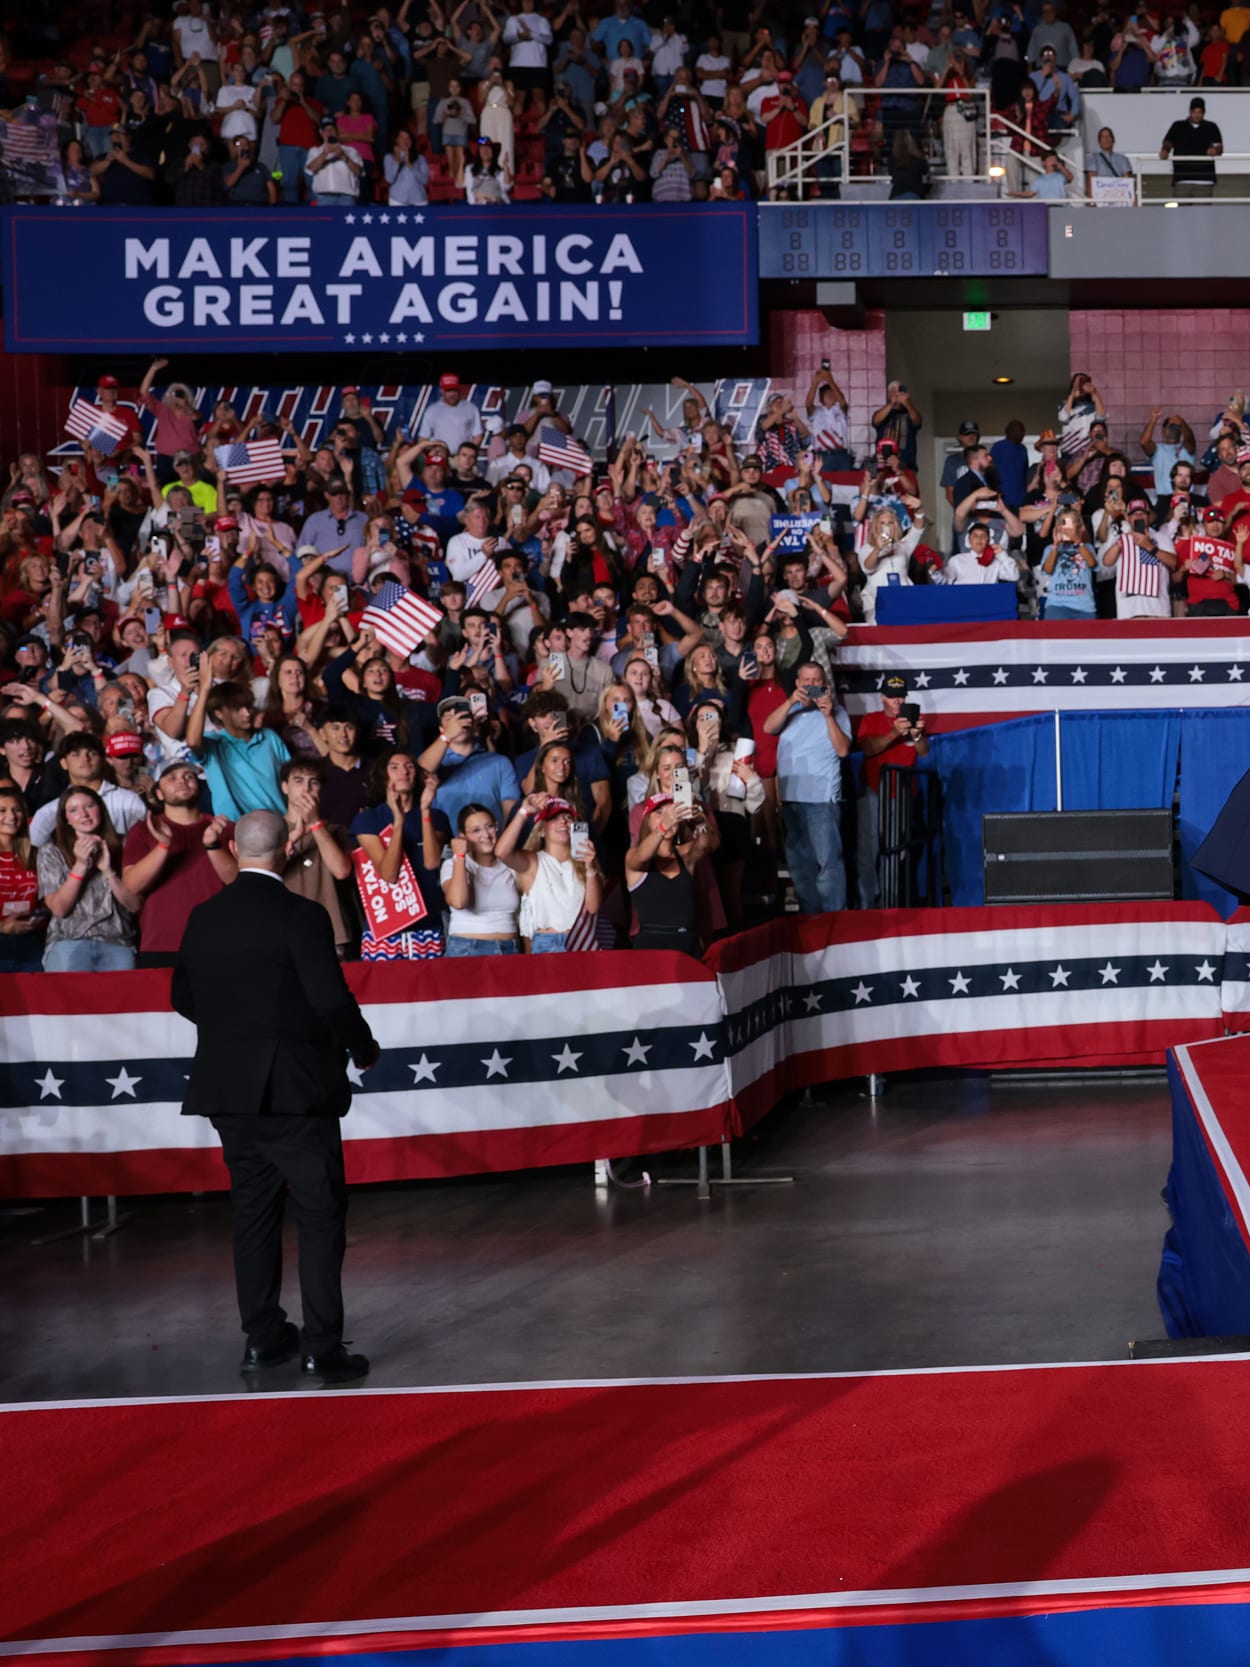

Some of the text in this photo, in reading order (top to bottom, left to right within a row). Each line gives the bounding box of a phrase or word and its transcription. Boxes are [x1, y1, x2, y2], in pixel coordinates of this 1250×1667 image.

[125, 234, 643, 279] MAKE AMERICA
[143, 281, 622, 327] GREAT AGAIN!
[1194, 541, 1215, 555] NO
[361, 860, 388, 923] NO TAX
